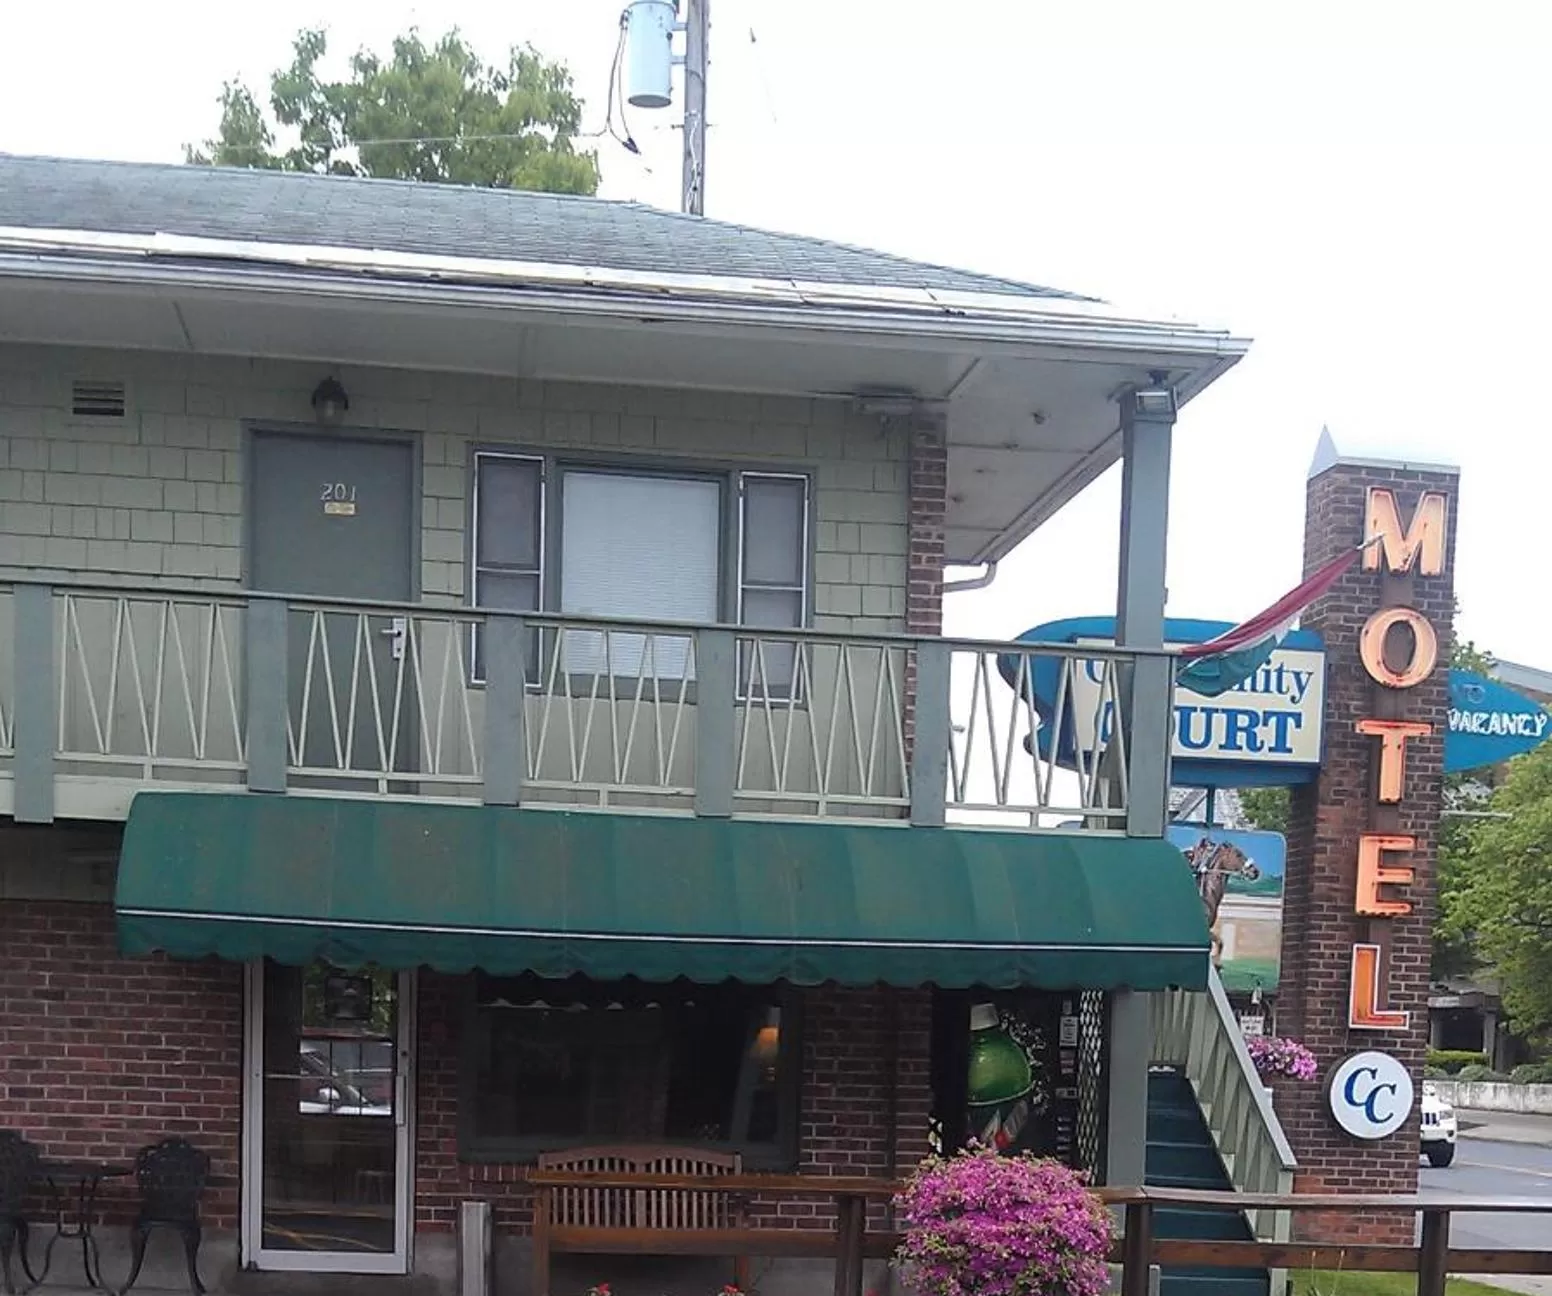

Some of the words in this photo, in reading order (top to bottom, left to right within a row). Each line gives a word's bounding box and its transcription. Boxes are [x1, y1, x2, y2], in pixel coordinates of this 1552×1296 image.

[320, 483, 356, 501] 201
[1101, 701, 1302, 753] URT
[1447, 708, 1547, 737] VACANCY
[1349, 487, 1448, 1029] MOTEL
[1344, 1067, 1397, 1124] CC
